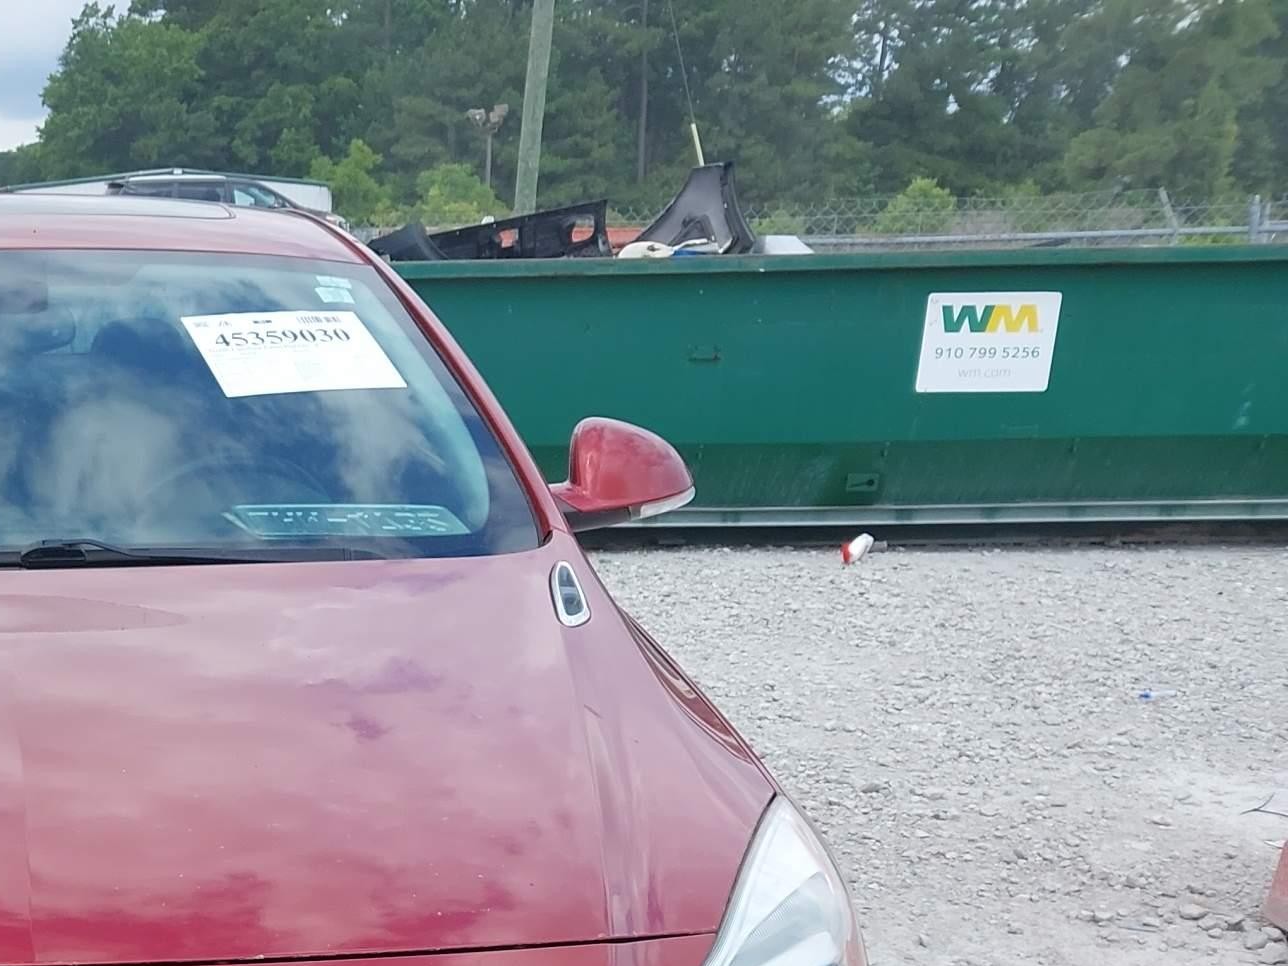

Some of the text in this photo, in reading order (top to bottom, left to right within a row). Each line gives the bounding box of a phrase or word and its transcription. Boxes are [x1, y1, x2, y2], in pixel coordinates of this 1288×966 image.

[941, 304, 1040, 333] WM
[215, 328, 350, 347] 45359030
[935, 346, 1040, 360] 910 799 5256
